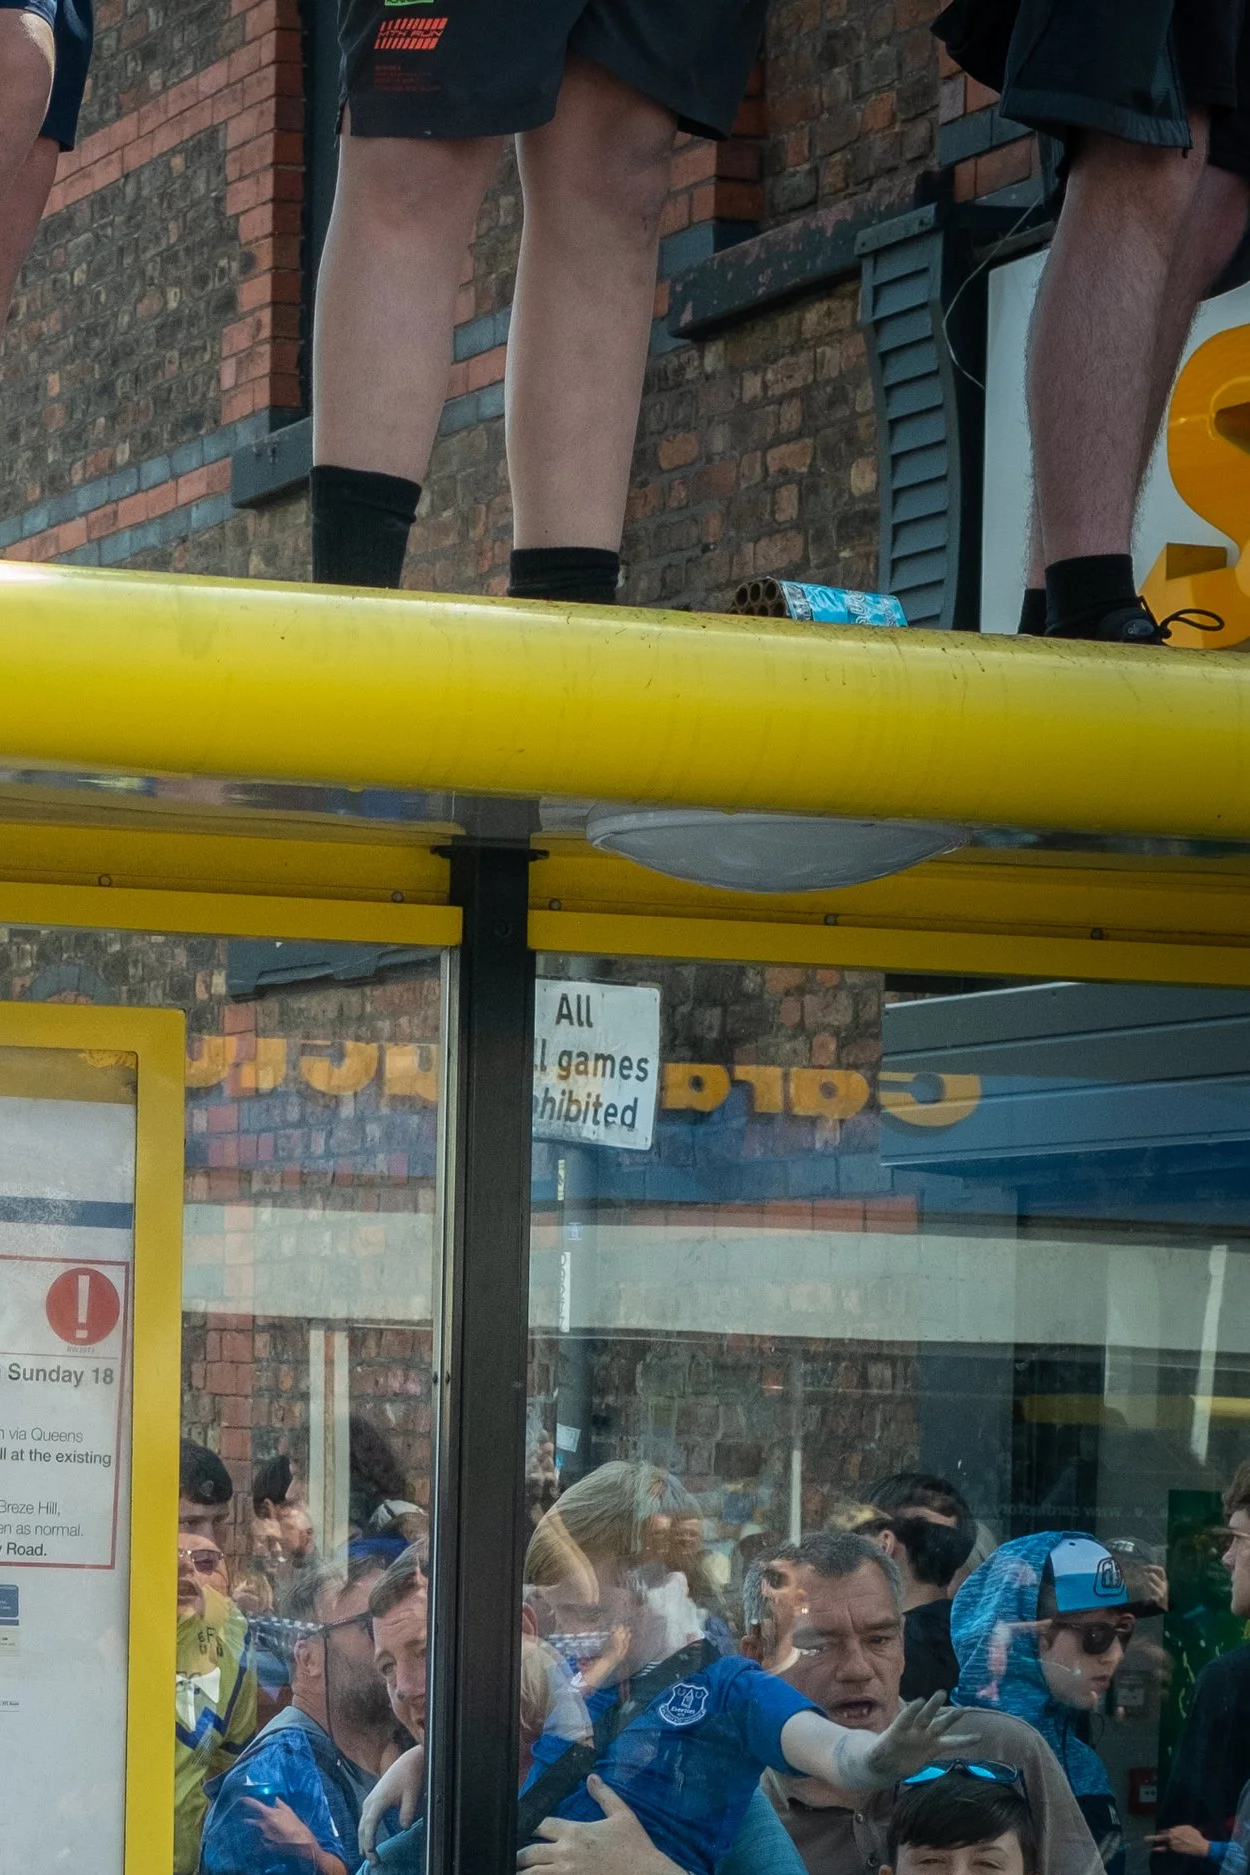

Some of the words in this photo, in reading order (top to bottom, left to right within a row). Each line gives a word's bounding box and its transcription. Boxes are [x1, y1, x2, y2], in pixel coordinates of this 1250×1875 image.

[555, 993, 593, 1028] All
[556, 1050, 650, 1083] games
[7, 1363, 84, 1387] Sunday
[93, 1367, 113, 1385] 18
[8, 1426, 27, 1440] via
[30, 1427, 83, 1443] Queens
[10, 1448, 25, 1461] at
[28, 1448, 51, 1462] the
[55, 1449, 112, 1468] existing
